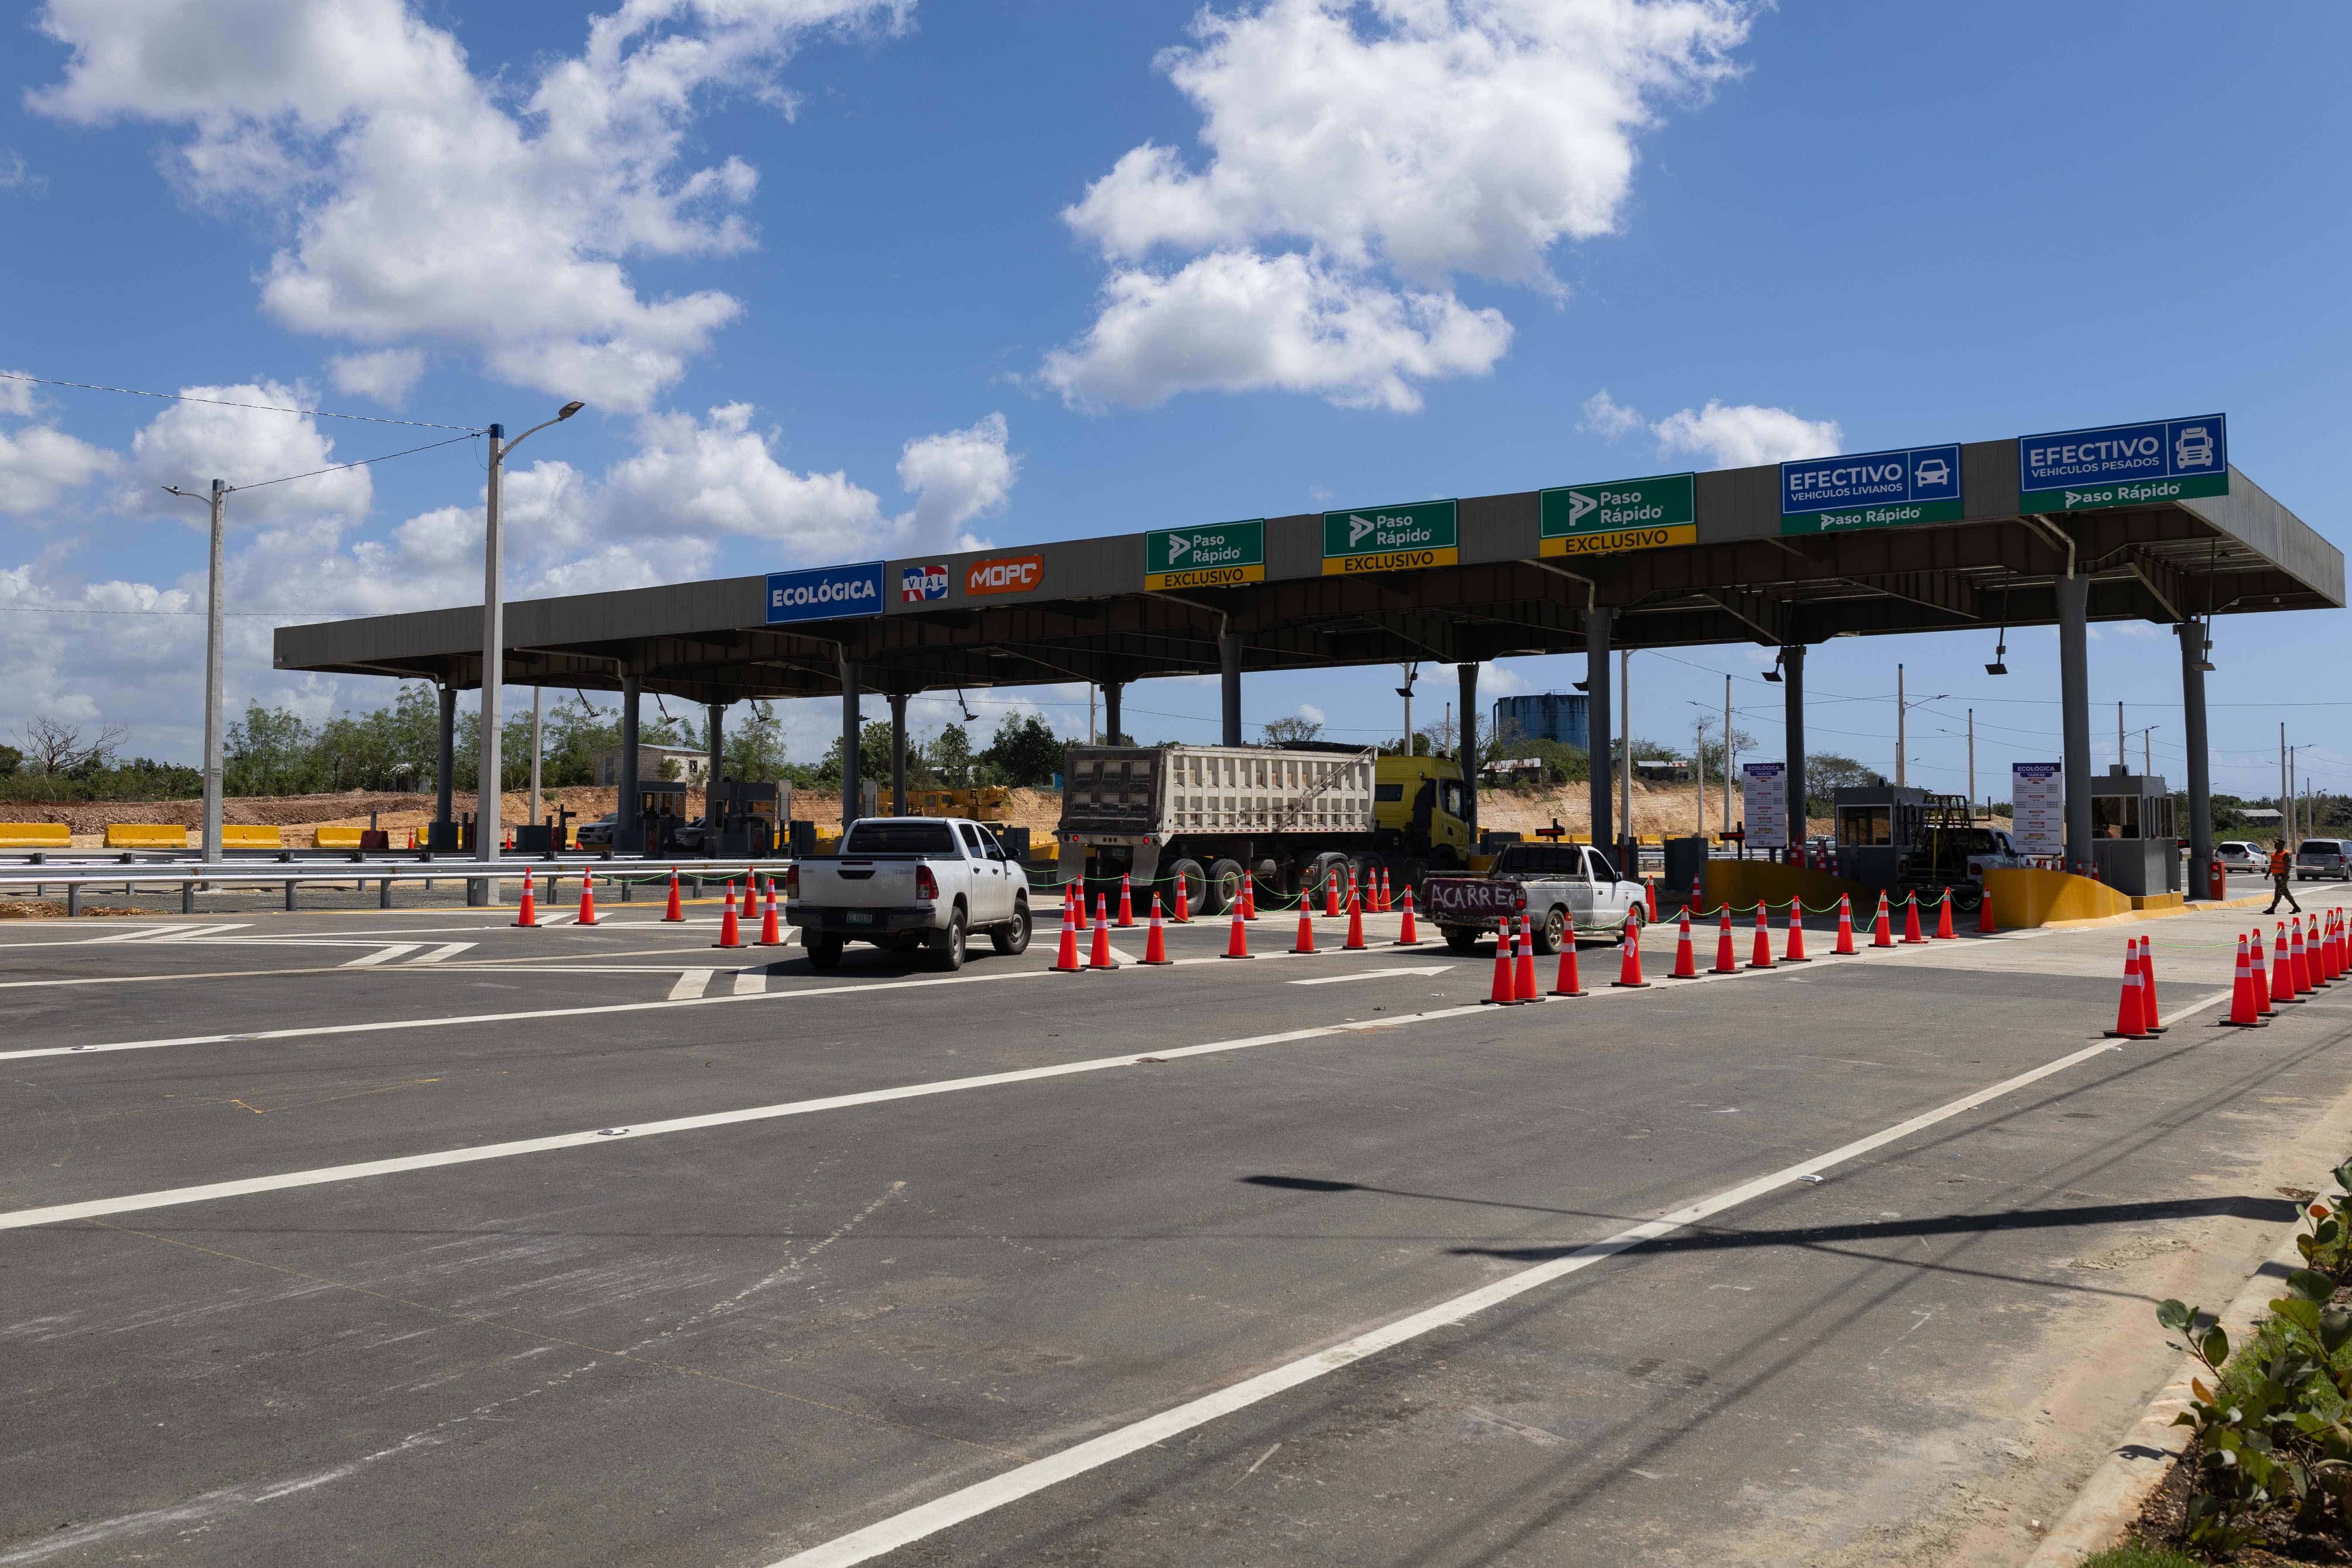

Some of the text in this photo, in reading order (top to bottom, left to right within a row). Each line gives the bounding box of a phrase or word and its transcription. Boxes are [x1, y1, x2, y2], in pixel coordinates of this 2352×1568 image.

[2030, 437, 2159, 467] EFECTIVO
[2032, 457, 2159, 478] VEHICULOS PESADOS
[1790, 464, 1903, 490] EFECTIVO
[1600, 492, 1642, 506] Paso
[1791, 483, 1903, 501] VEHICULOS LIVIANOS
[2065, 491, 2112, 508] Paso
[1377, 515, 1413, 529] Paso
[1821, 513, 1861, 530] Paso
[1193, 534, 1225, 548] Paso
[1566, 530, 1668, 553] EXCLUSIVO
[1344, 551, 1434, 572] EXCLUSIVO
[908, 576, 943, 589] VIAL
[971, 563, 1037, 588] MOPC
[1164, 569, 1243, 587] EXCLUSIVO
[772, 579, 876, 607] ECOLÓGICA
